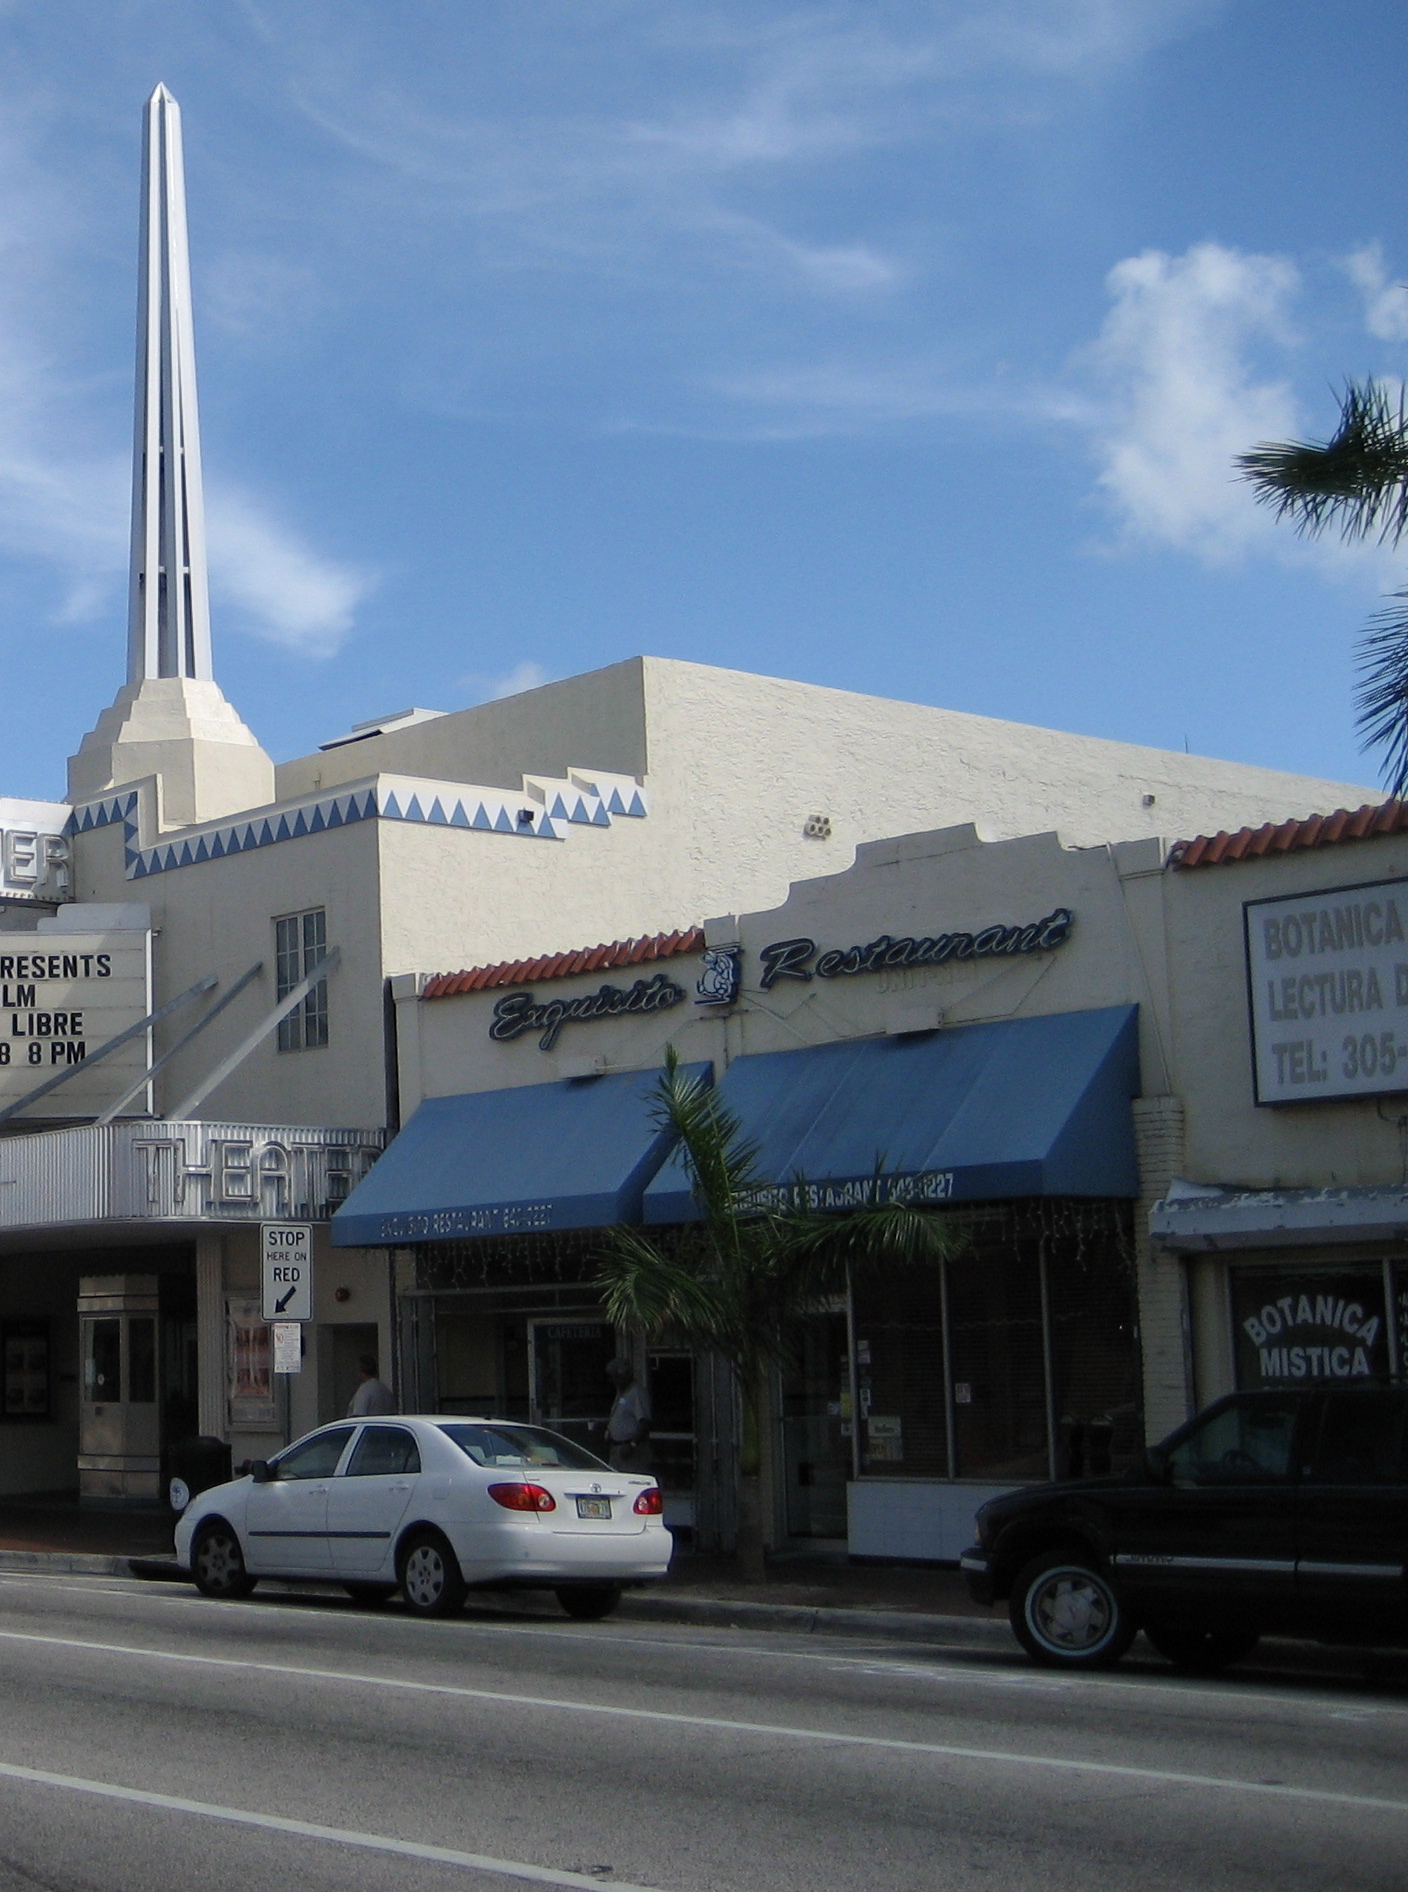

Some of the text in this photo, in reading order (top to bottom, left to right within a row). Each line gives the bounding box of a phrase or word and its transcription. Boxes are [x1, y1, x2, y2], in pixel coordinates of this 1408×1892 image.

[1263, 898, 1404, 961] BOTANICA
[489, 973, 687, 1051] Exquisito
[760, 907, 1072, 989] Restaurant
[1267, 967, 1383, 1021] LECTURA
[12, 1012, 84, 1037] LIBRE
[51, 1041, 85, 1065] PM
[1271, 1040, 1327, 1085] TEL:
[268, 1231, 305, 1246] STOP
[266, 1252, 307, 1262] HERE ON
[273, 1267, 300, 1282] RED
[1242, 1294, 1379, 1347] BOTANICA
[1259, 1346, 1370, 1377] MISTICA
